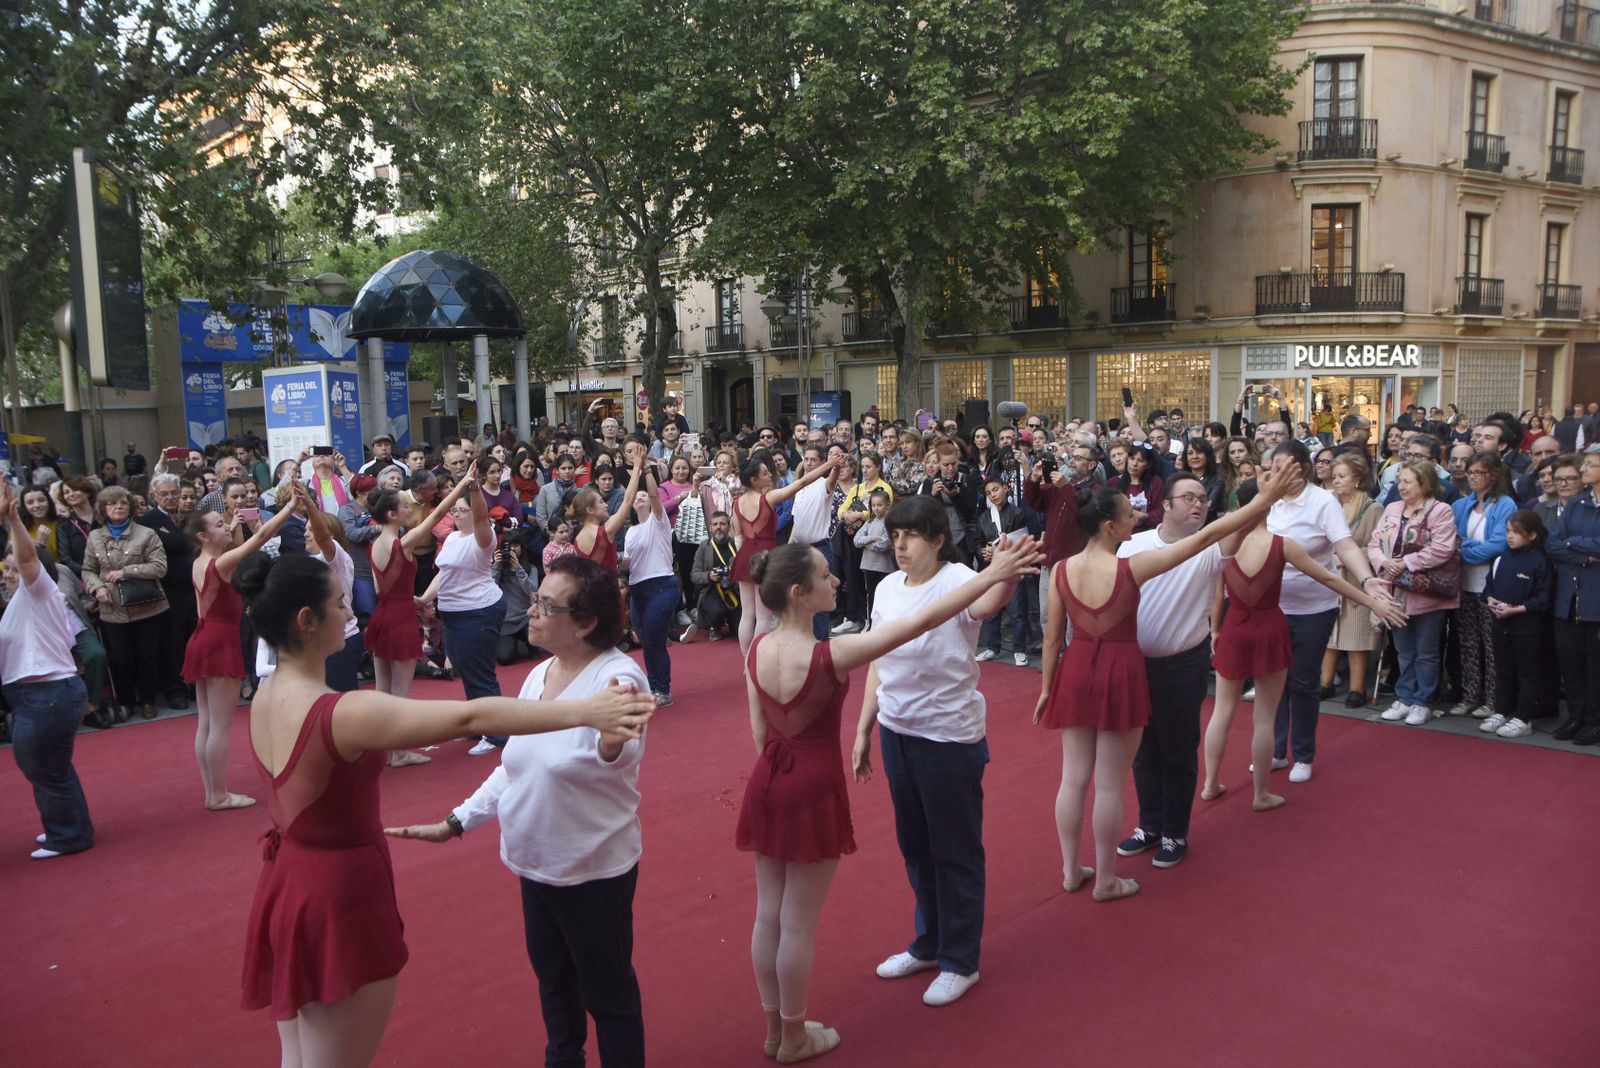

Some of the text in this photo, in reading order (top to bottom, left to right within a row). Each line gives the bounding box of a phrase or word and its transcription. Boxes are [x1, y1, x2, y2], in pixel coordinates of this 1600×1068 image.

[1295, 344, 1419, 367] PULL&BEAR
[287, 381, 318, 391] FERIA DEL
[343, 381, 356, 391] FERIA
[287, 391, 306, 400] LIBRO
[344, 392, 353, 401] DEL
[344, 403, 358, 413] LIBRO
